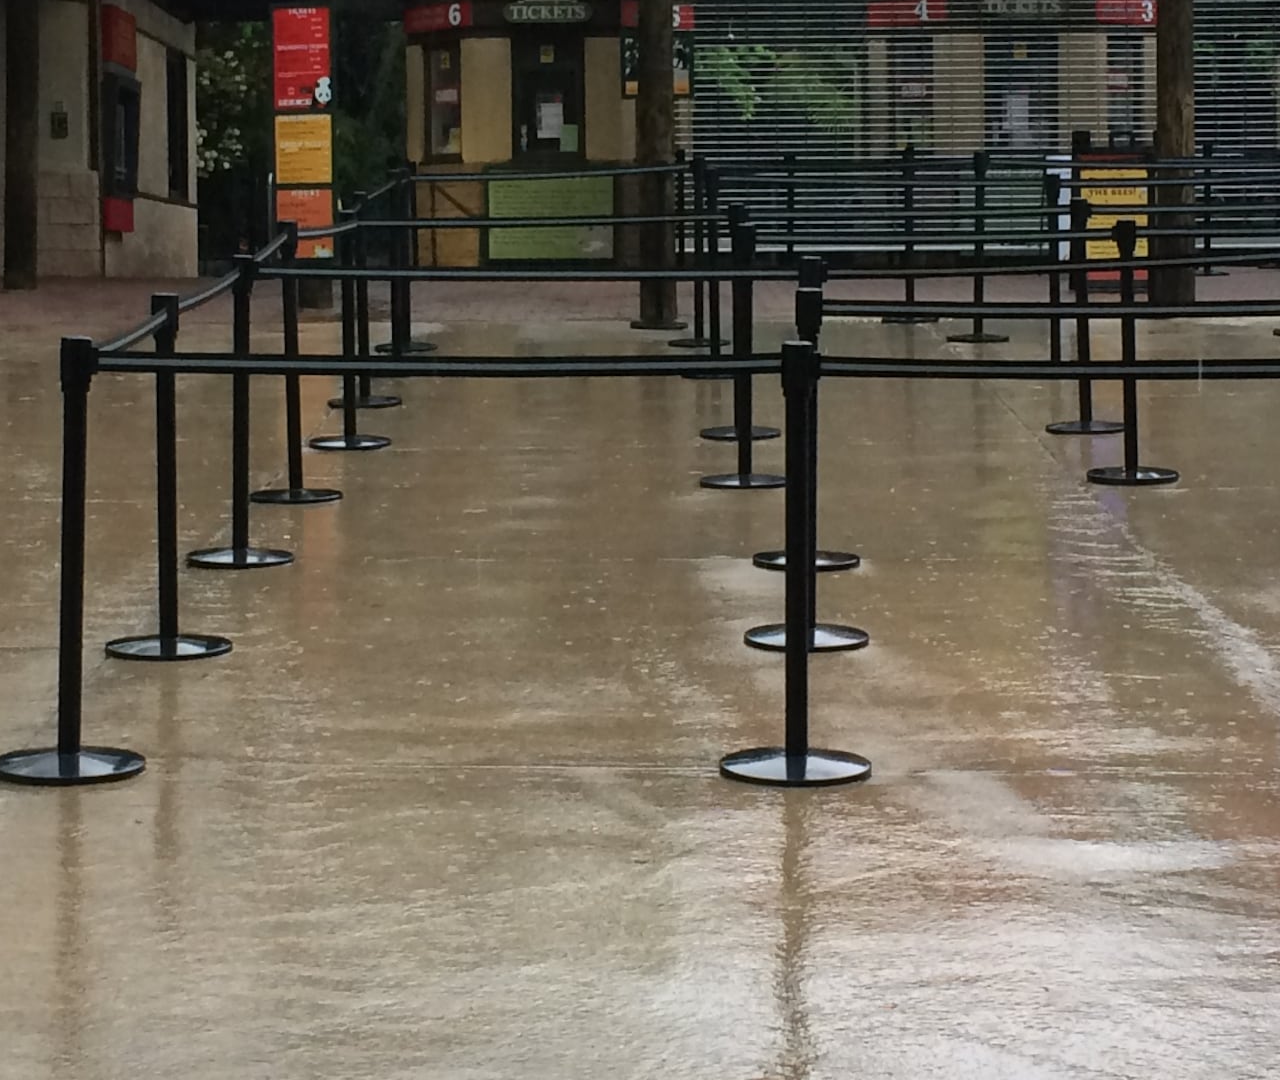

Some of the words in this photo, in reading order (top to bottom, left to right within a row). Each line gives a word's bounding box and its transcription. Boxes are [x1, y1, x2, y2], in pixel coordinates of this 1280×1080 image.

[448, 3, 461, 26] 6
[509, 5, 586, 20] TICKETS
[914, 0, 929, 20] 4
[983, 0, 1061, 13] TICKETS
[1141, 0, 1153, 22] 3
